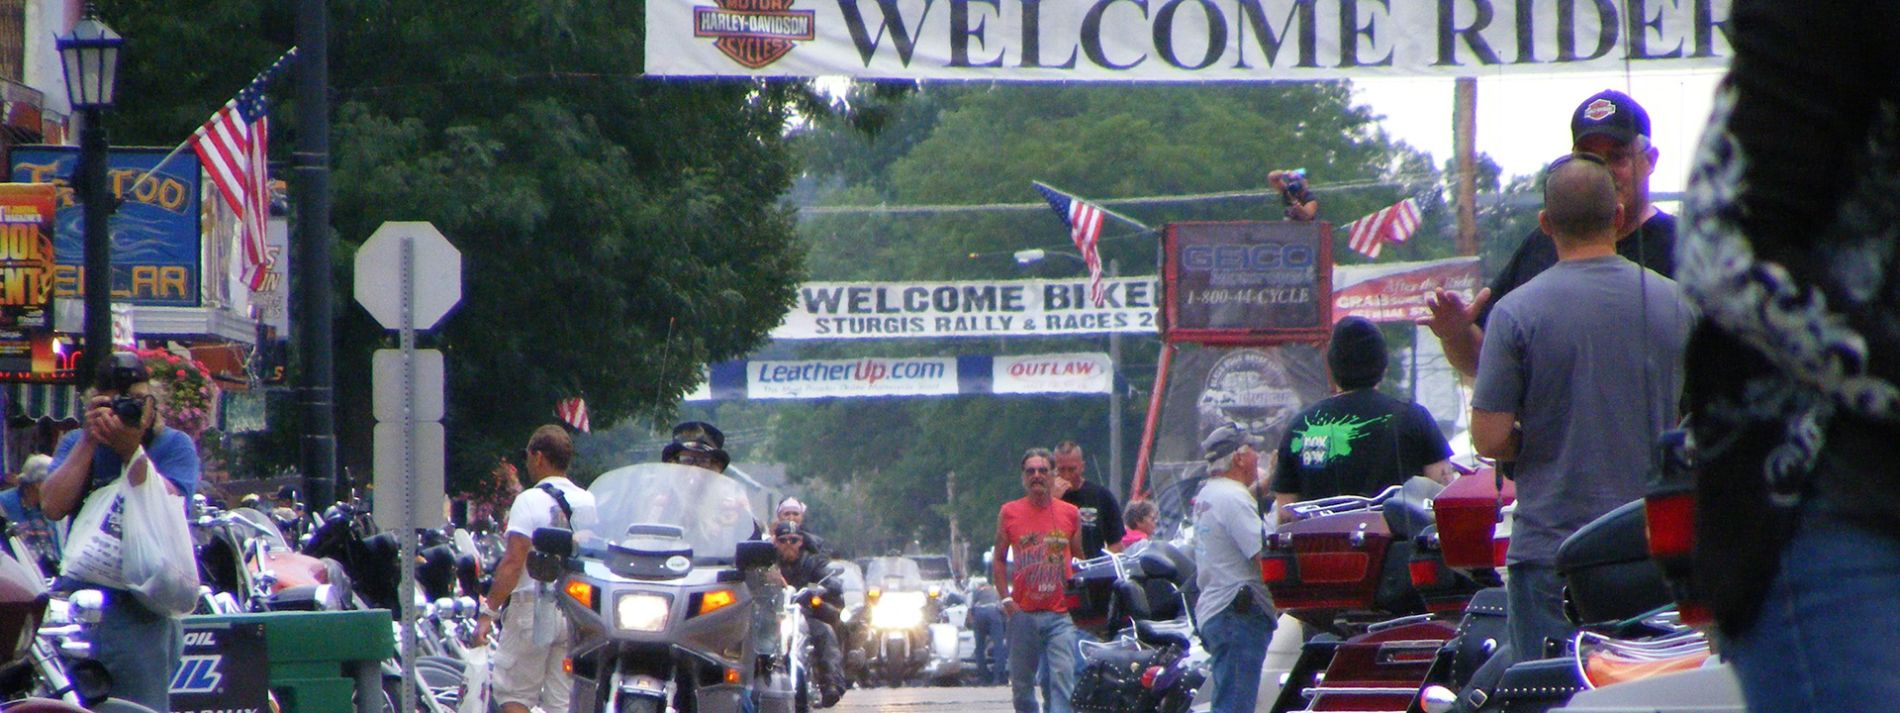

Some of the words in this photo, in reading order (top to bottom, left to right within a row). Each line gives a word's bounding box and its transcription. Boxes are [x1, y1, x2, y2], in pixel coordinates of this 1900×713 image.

[701, 12, 808, 34] HARLEY-DAVIDSON
[836, 0, 1395, 69] WELCOME
[722, 38, 787, 62] CYCLES
[1183, 242, 1315, 271] GEICO
[802, 286, 1024, 315] WELCOME
[1043, 281, 1160, 311] BIKE
[815, 317, 925, 335] STURGIS
[935, 315, 1013, 333] RALLY
[1023, 318, 1037, 330] &
[1045, 312, 1127, 330] RACES
[759, 360, 945, 384] LeatherUp.com
[1010, 362, 1094, 377] OUTLAW
[182, 632, 215, 646] OIL
